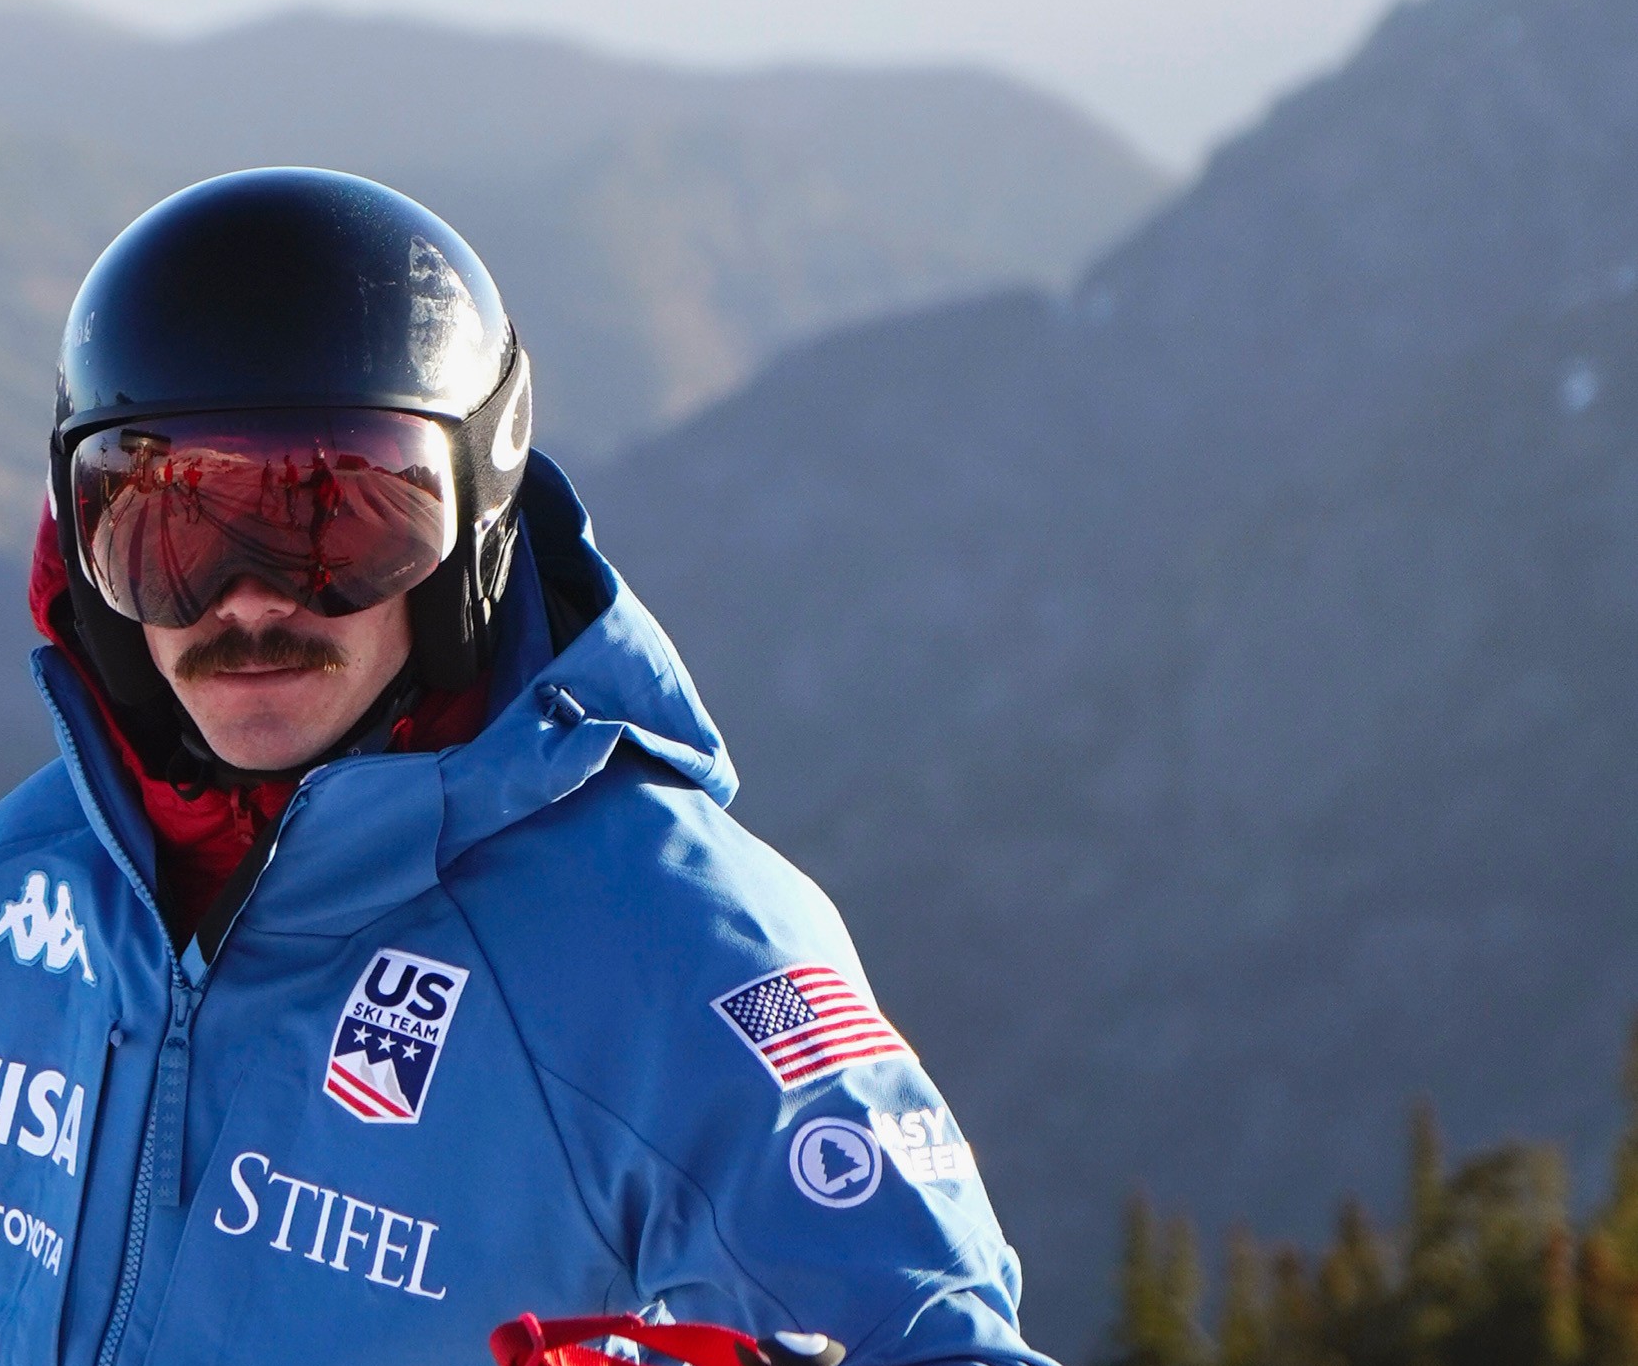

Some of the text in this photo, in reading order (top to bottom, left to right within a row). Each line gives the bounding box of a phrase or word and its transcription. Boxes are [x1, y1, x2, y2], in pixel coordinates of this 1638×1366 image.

[365, 956, 455, 1021] US
[353, 1002, 439, 1041] SKI TEAM
[214, 1152, 447, 1301] STIFEL
